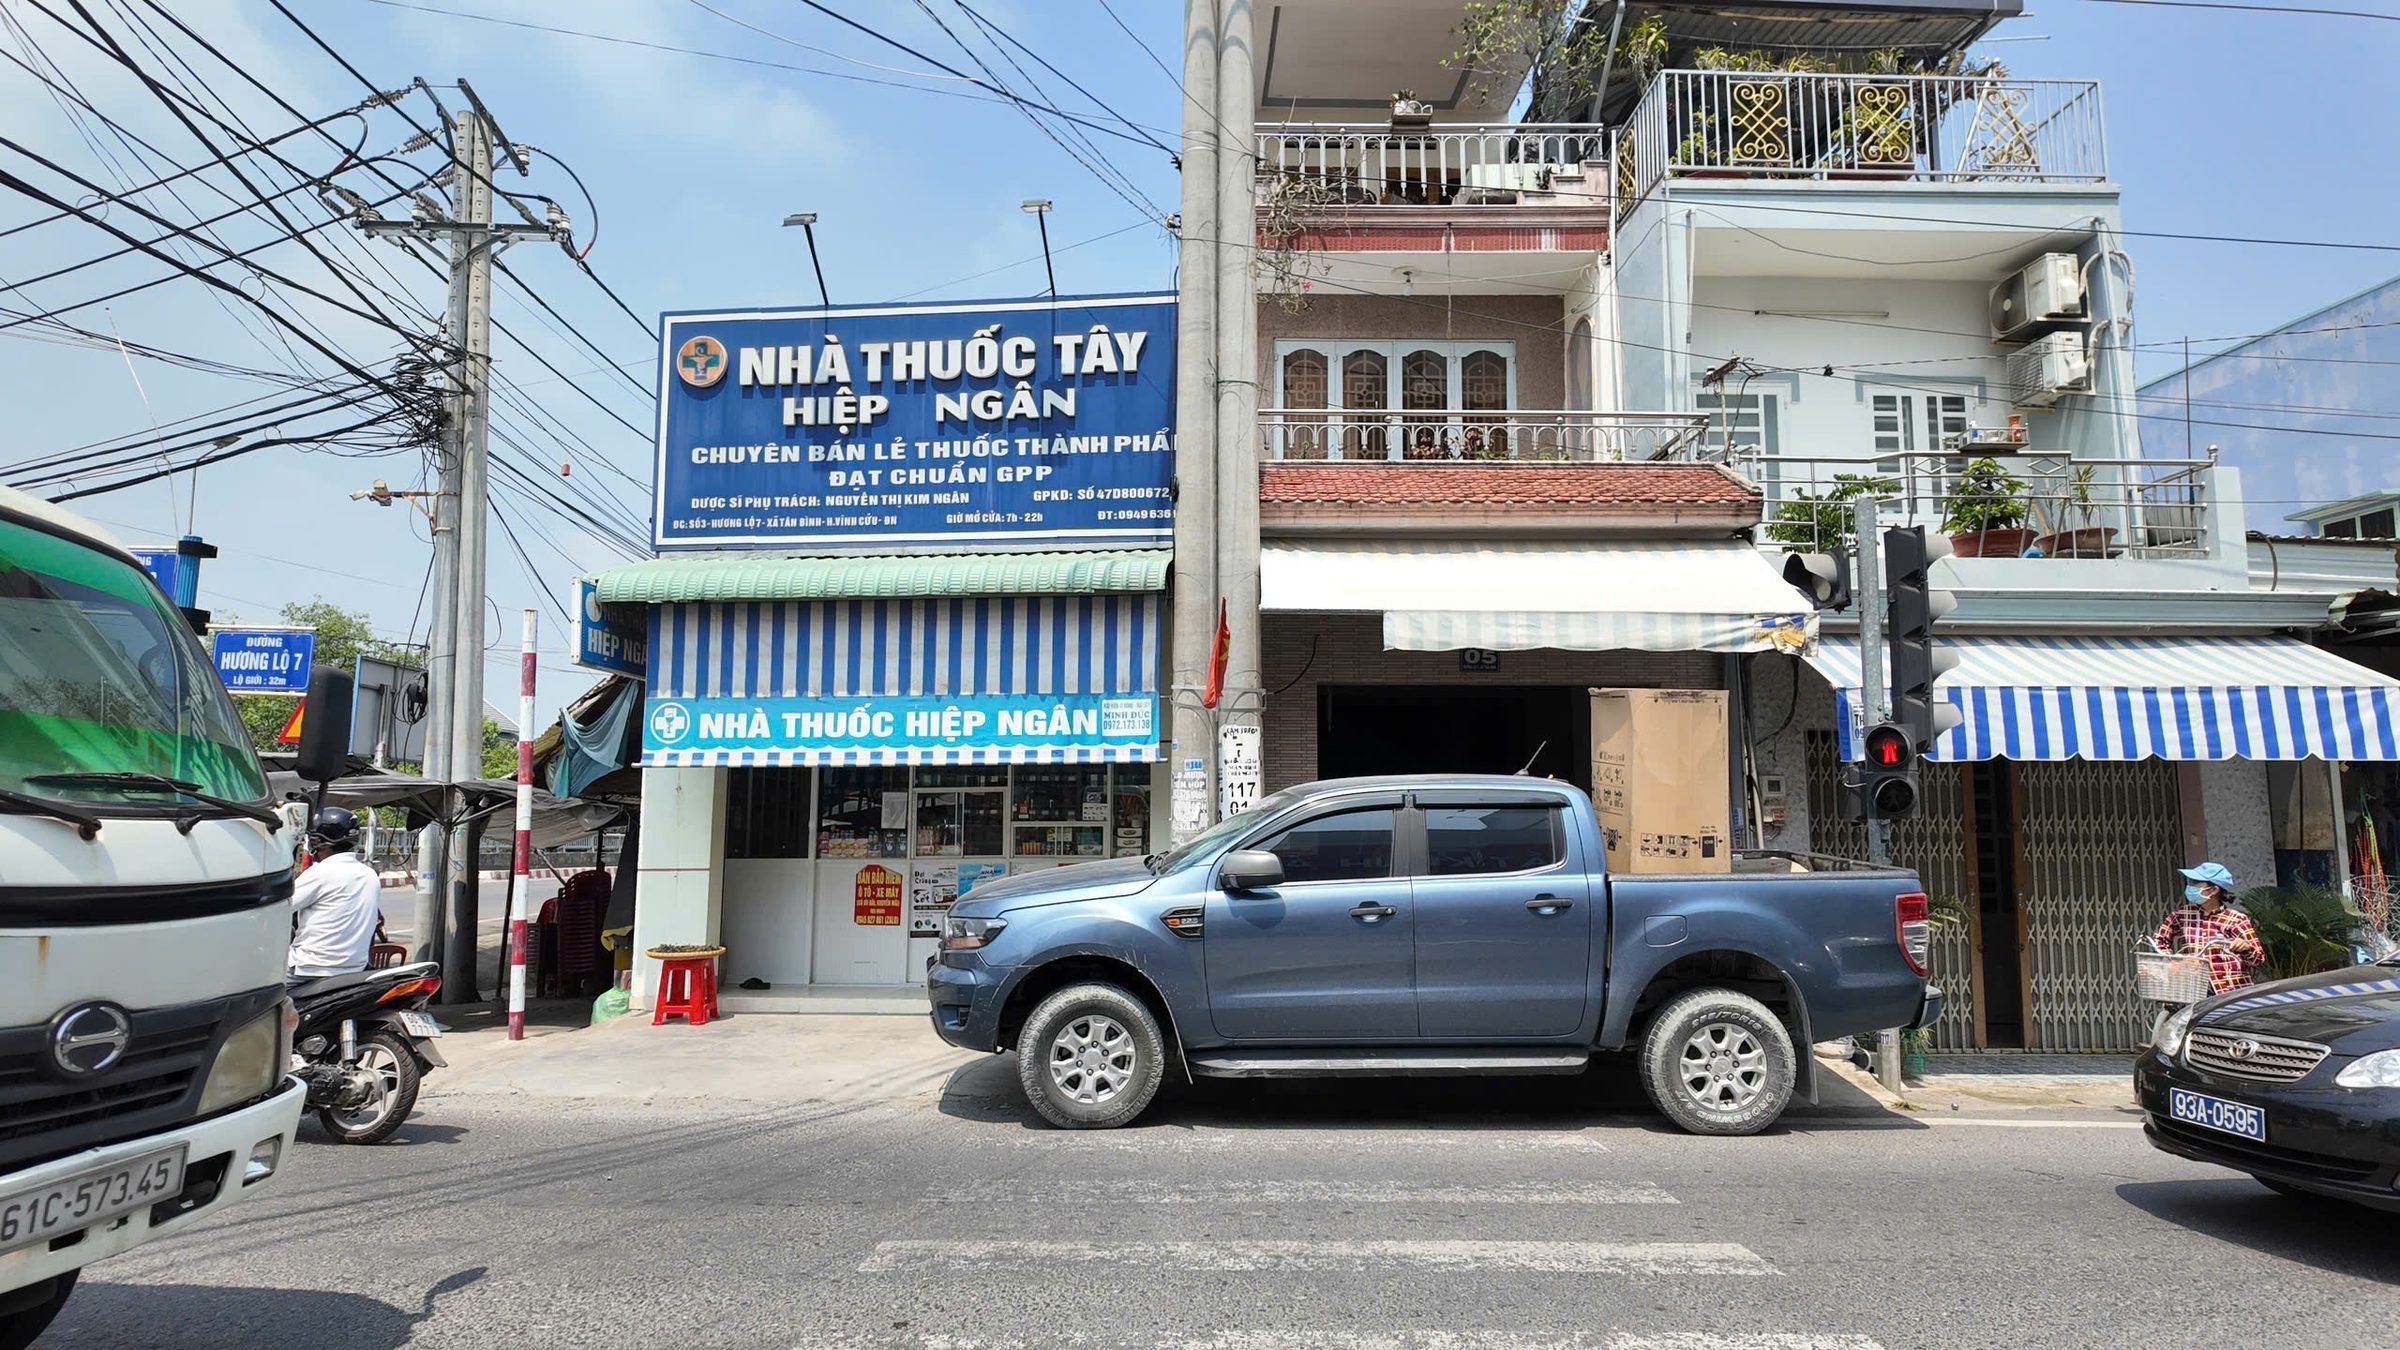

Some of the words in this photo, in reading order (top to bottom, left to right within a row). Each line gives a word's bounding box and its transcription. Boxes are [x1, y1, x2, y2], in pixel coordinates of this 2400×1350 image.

[739, 334, 852, 386] NHÀ
[860, 323, 1036, 383] THUỐC
[1053, 324, 1147, 375] TÂY
[783, 386, 889, 435] HIỆP
[935, 380, 1075, 423] NGÂN
[691, 442, 800, 464] CHUYÊN
[808, 440, 865, 462] BÁN
[874, 437, 906, 461] LẺ
[914, 433, 1009, 459] THUỐC
[1014, 433, 1109, 456] THÀNH
[829, 470, 882, 491] ĐẠT
[890, 461, 987, 485] CHUẨN
[996, 466, 1053, 482] GPP
[691, 496, 726, 511] DƯỢC
[774, 494, 821, 508] TRÁCH:
[881, 494, 901, 508] THỊ
[904, 493, 930, 505] KIM
[933, 491, 969, 504] NGÂN
[1033, 489, 1073, 501] GPKD:
[587, 626, 620, 661] HIỆP
[1464, 649, 1497, 664] 05
[221, 650, 269, 670] HƯƠNG
[272, 649, 290, 674] LỘ
[294, 653, 303, 671] 7
[700, 707, 771, 739] NHÀ
[782, 703, 894, 738] THUỐC
[906, 705, 986, 742] HIỆP
[997, 704, 1098, 736] NGÂN
[1228, 782, 1256, 797] 117
[2175, 1093, 2258, 1135] 93A-0595
